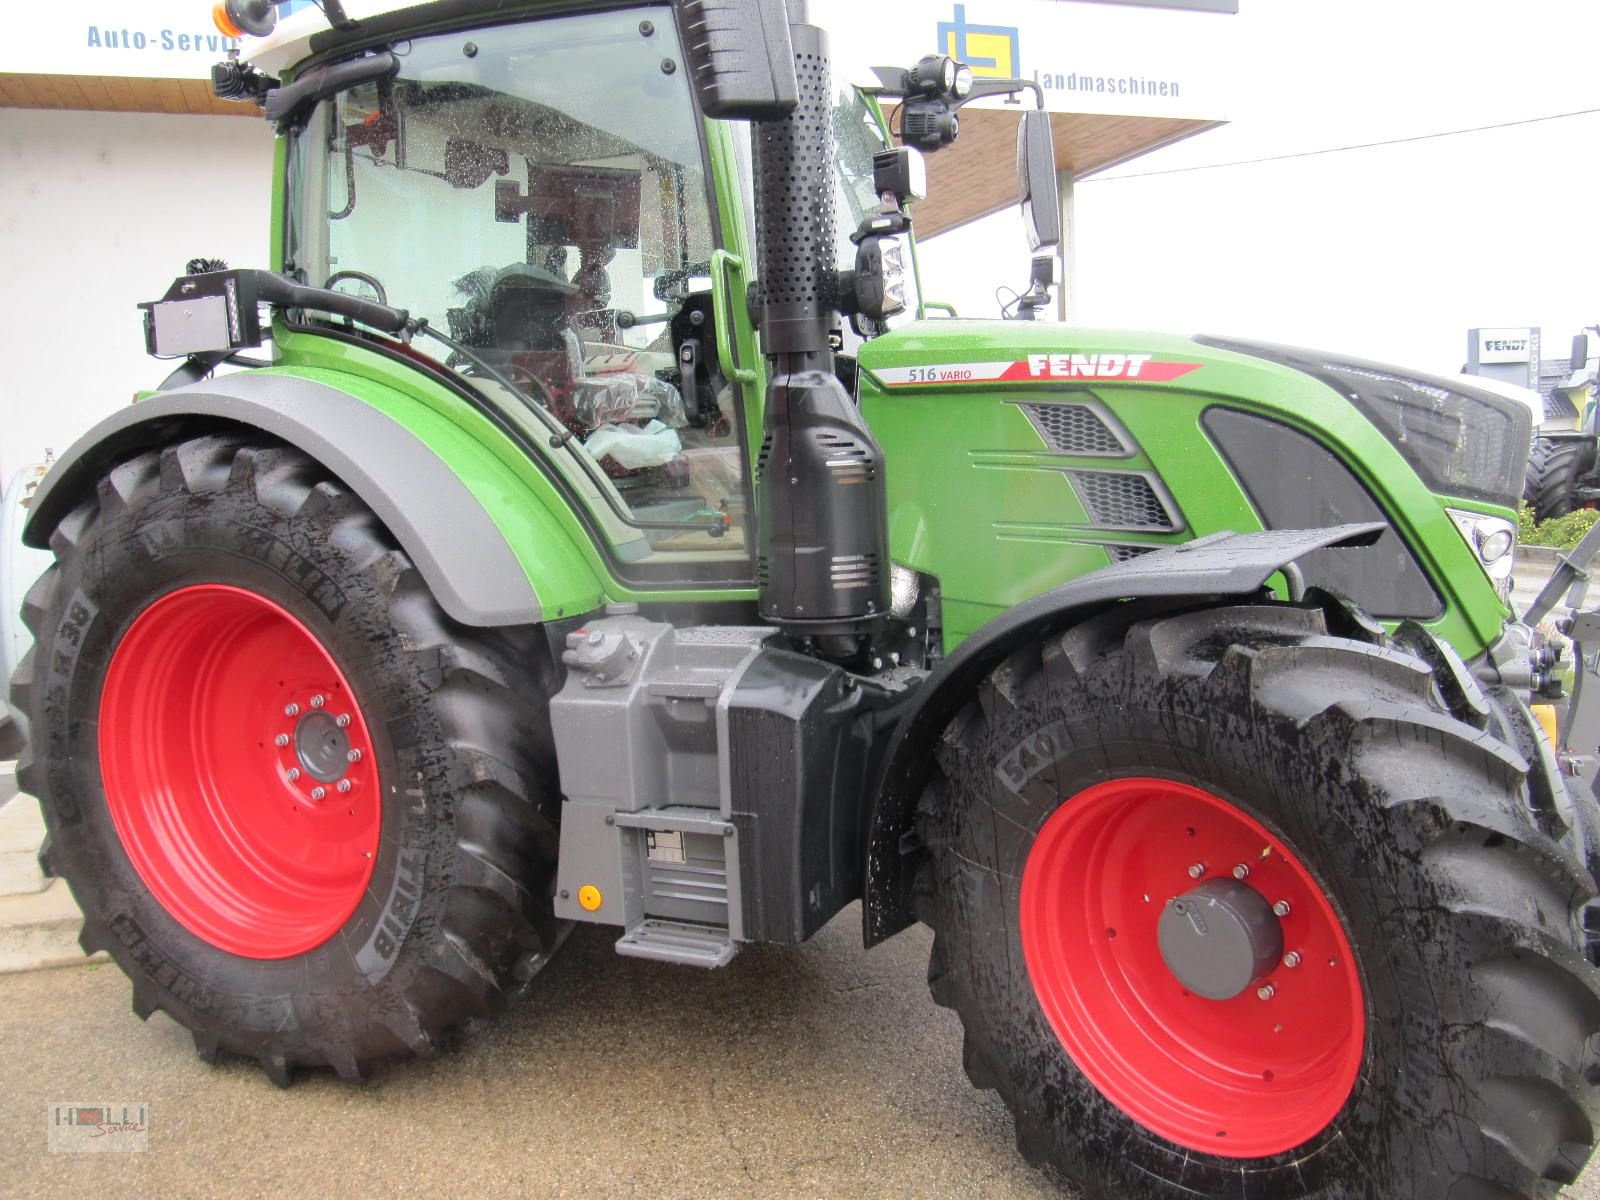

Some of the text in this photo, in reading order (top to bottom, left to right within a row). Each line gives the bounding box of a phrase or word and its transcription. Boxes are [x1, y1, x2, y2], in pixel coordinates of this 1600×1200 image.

[1484, 340, 1528, 352] FENDT
[1027, 354, 1152, 377] FENDT
[909, 368, 972, 382] 516 VARIO
[60, 600, 91, 648] 38
